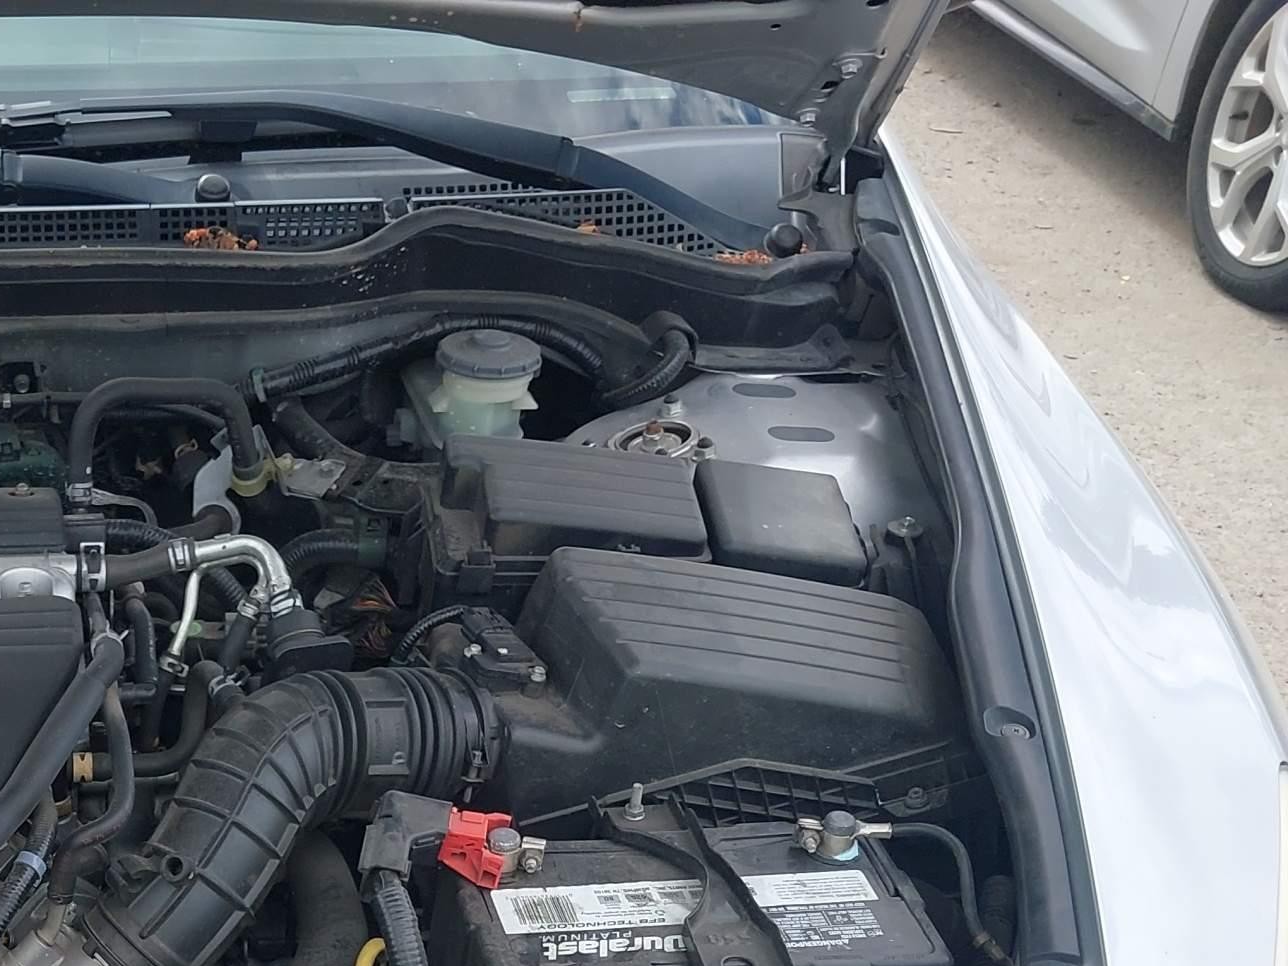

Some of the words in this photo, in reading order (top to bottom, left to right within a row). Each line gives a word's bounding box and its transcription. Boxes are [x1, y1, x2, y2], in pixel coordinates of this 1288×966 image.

[536, 919, 638, 931] TECHNOLOGY
[638, 917, 666, 926] EFB
[541, 933, 687, 961] Duralast
